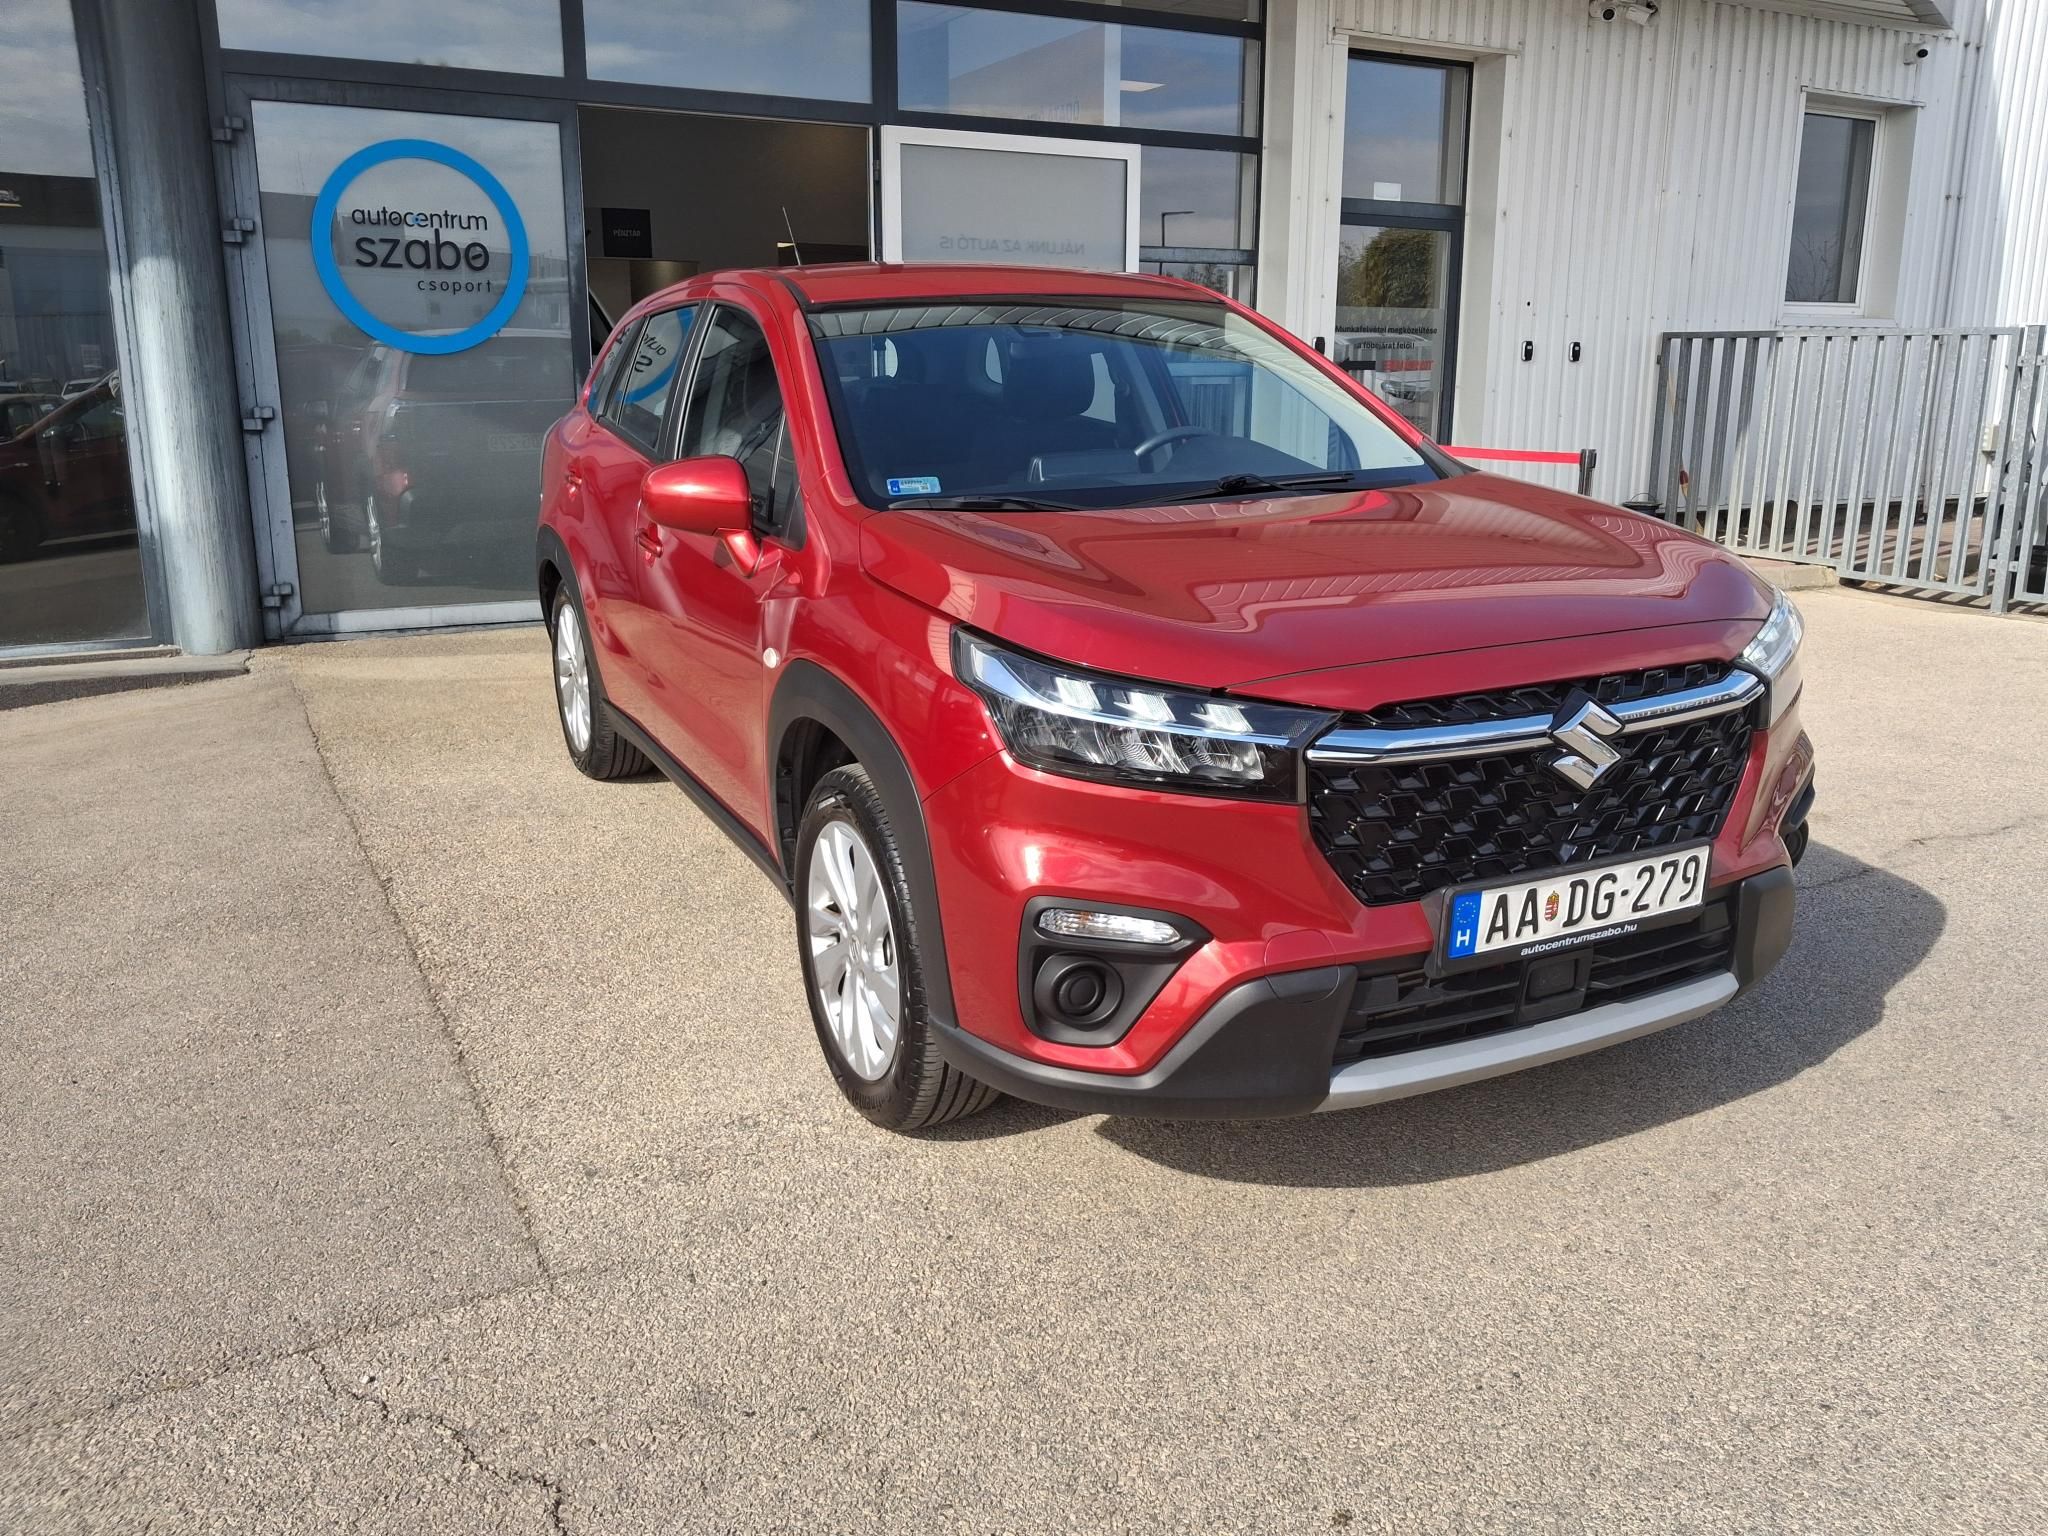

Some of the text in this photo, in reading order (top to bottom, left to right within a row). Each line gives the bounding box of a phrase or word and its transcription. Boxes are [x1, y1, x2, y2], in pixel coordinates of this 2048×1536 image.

[417, 279, 492, 295] csoport
[1455, 854, 1701, 948] H AA DG-279
[1520, 922, 1638, 957] autocentrumszabo.hu
